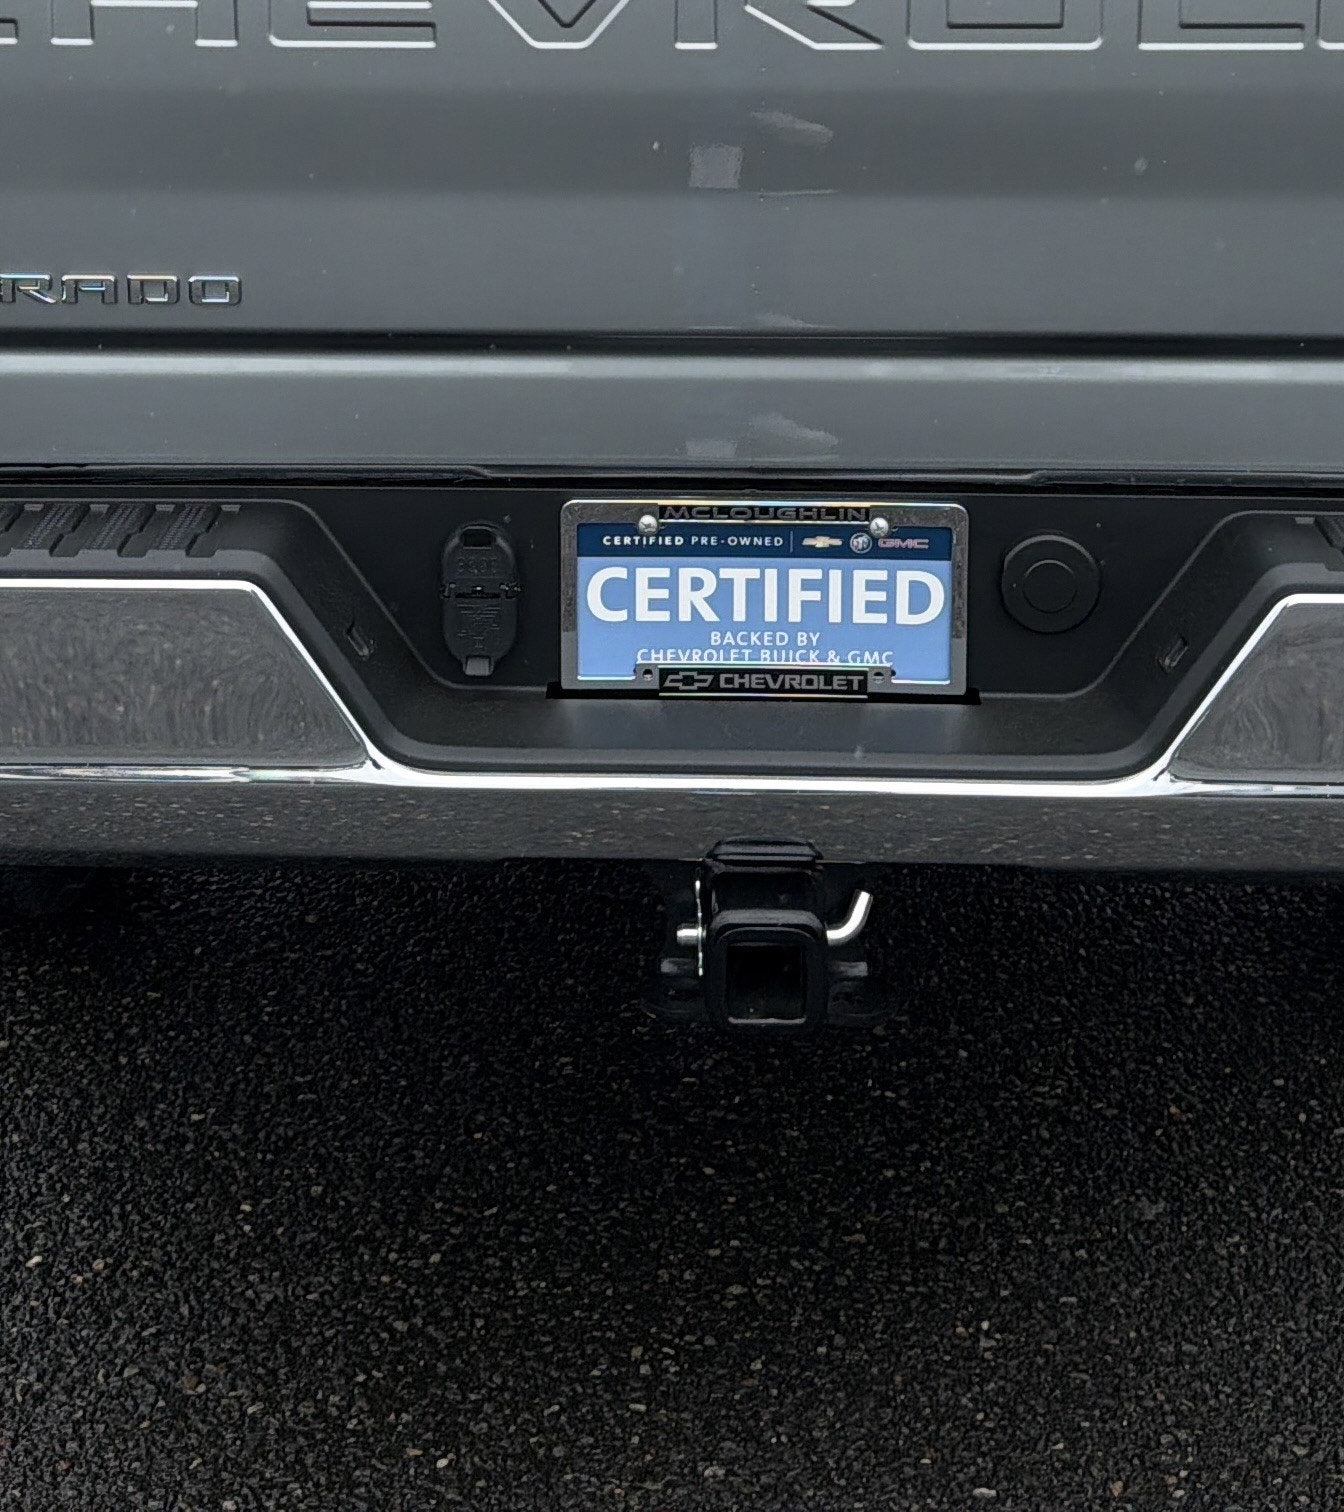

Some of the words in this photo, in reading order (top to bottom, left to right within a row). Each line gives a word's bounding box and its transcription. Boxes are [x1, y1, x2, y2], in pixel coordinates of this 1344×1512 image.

[663, 505, 867, 522] MCLOUGHLIN
[602, 535, 684, 547] CERTIFIED
[690, 536, 783, 547] PRE-OWNED
[878, 538, 929, 549] GMC
[586, 566, 946, 626] CERTIFIED
[710, 631, 788, 646] BACKED
[797, 632, 820, 647] BY
[637, 648, 750, 663] CHEVROLET
[760, 649, 820, 664] BUICK
[828, 650, 841, 664] &
[847, 650, 895, 665] GMC
[719, 674, 864, 691] CHEVROLET
